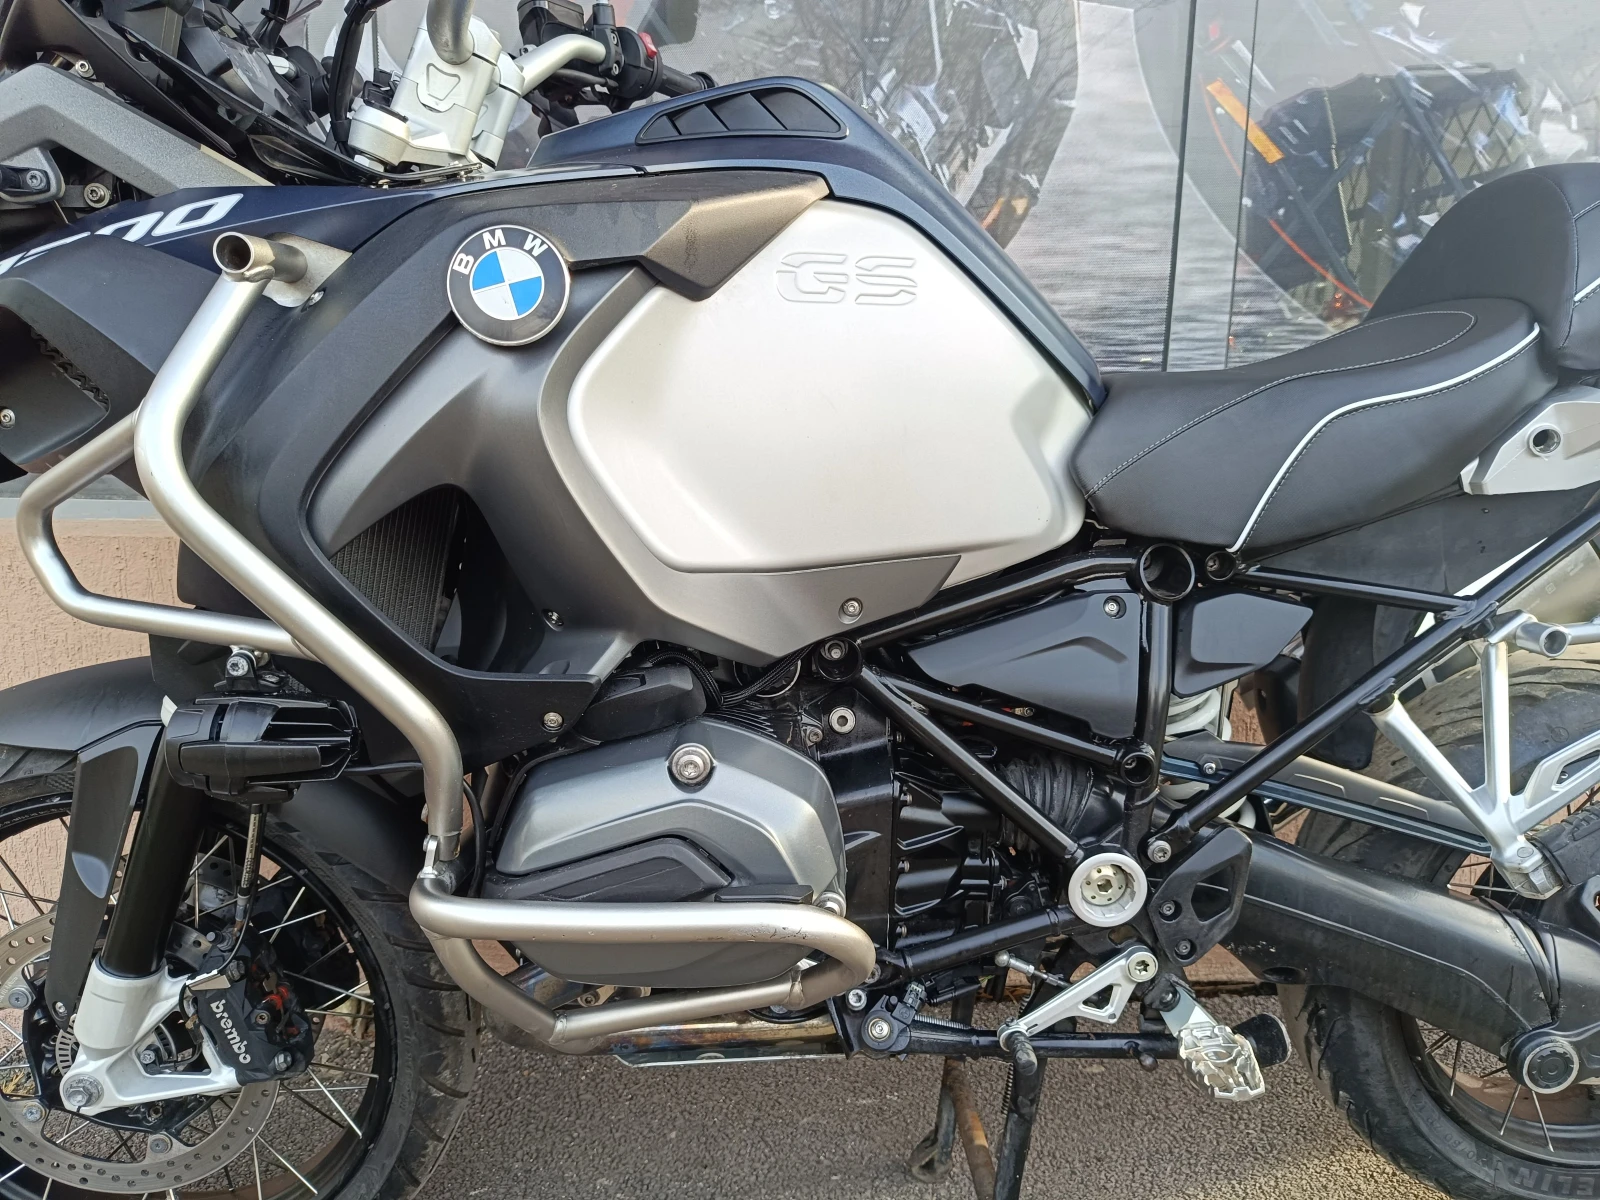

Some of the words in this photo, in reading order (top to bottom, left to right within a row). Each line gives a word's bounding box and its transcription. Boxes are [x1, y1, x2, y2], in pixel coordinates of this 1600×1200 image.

[452, 228, 549, 275] BMW
[776, 252, 918, 306] GS
[210, 999, 251, 1064] brembo
